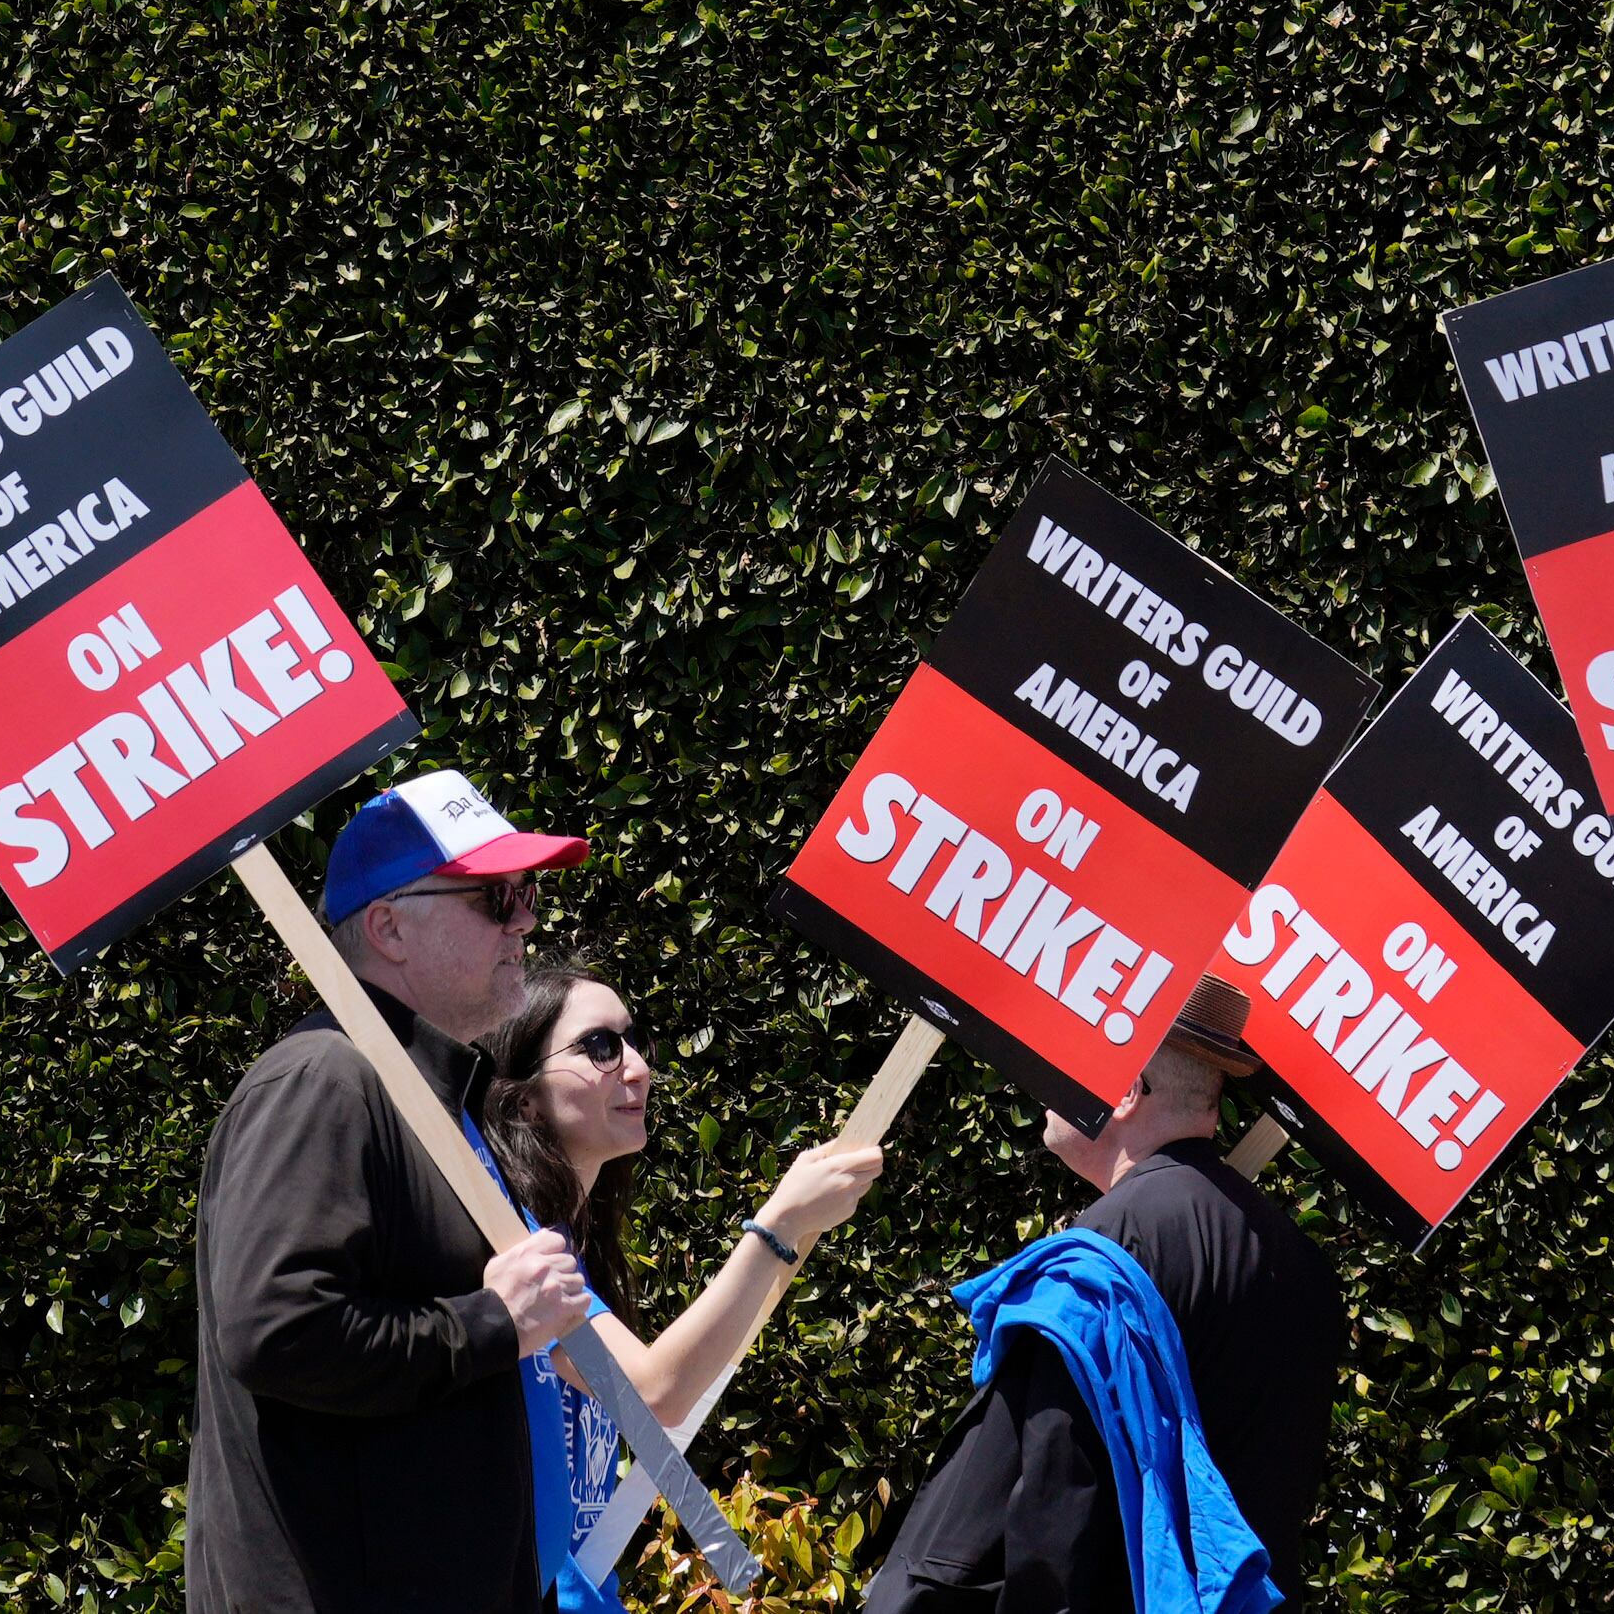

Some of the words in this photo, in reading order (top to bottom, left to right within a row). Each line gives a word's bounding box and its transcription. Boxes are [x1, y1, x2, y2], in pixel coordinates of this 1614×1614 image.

[67, 602, 162, 691] ON
[1028, 516, 1209, 665] WRITERS
[1203, 645, 1321, 746] GUILD
[1119, 660, 1170, 707] OF
[1014, 663, 1199, 813] AMERICA
[1431, 669, 1584, 828] WRITERS
[1016, 789, 1101, 871] ON
[1400, 805, 1556, 966] AMERICA
[1494, 816, 1542, 860] OF
[836, 773, 1173, 1043] STRIKE!
[1383, 922, 1458, 1003] ON
[1222, 884, 1505, 1169] STRIKE!
